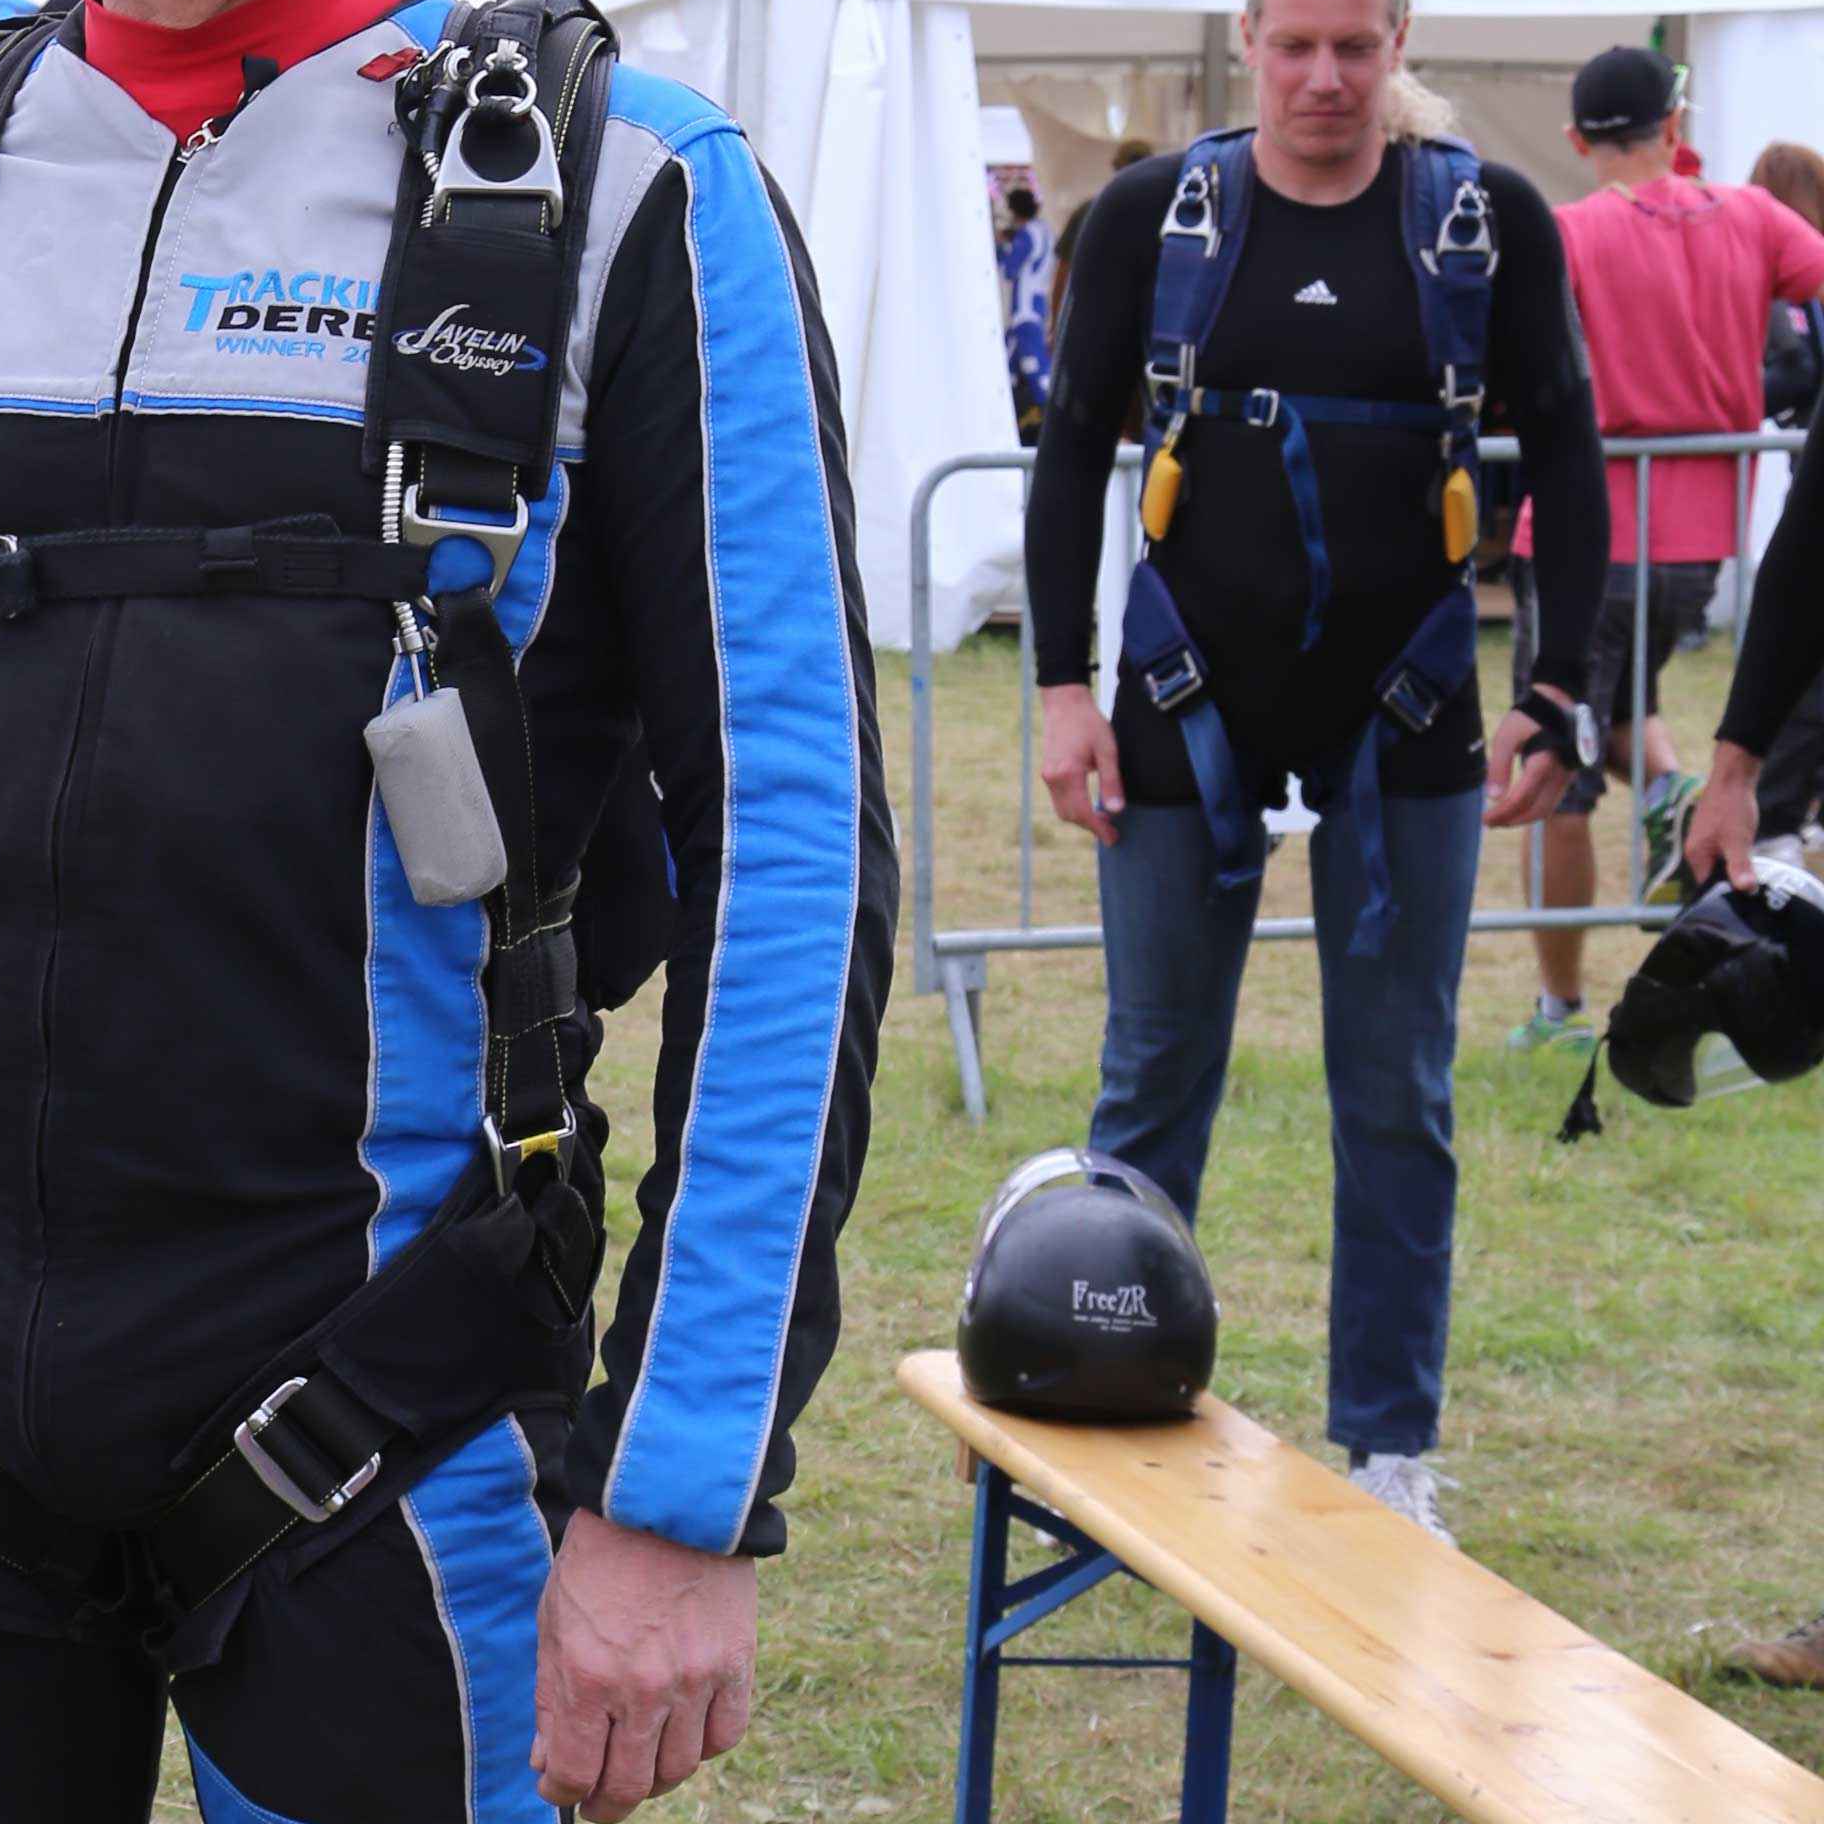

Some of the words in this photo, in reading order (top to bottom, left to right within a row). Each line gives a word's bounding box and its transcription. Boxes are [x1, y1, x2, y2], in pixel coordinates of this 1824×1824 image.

[180, 269, 382, 333] TRACKI
[215, 336, 326, 360] WINNER
[396, 303, 527, 355] JAVELIN
[430, 344, 516, 376] Odyssey
